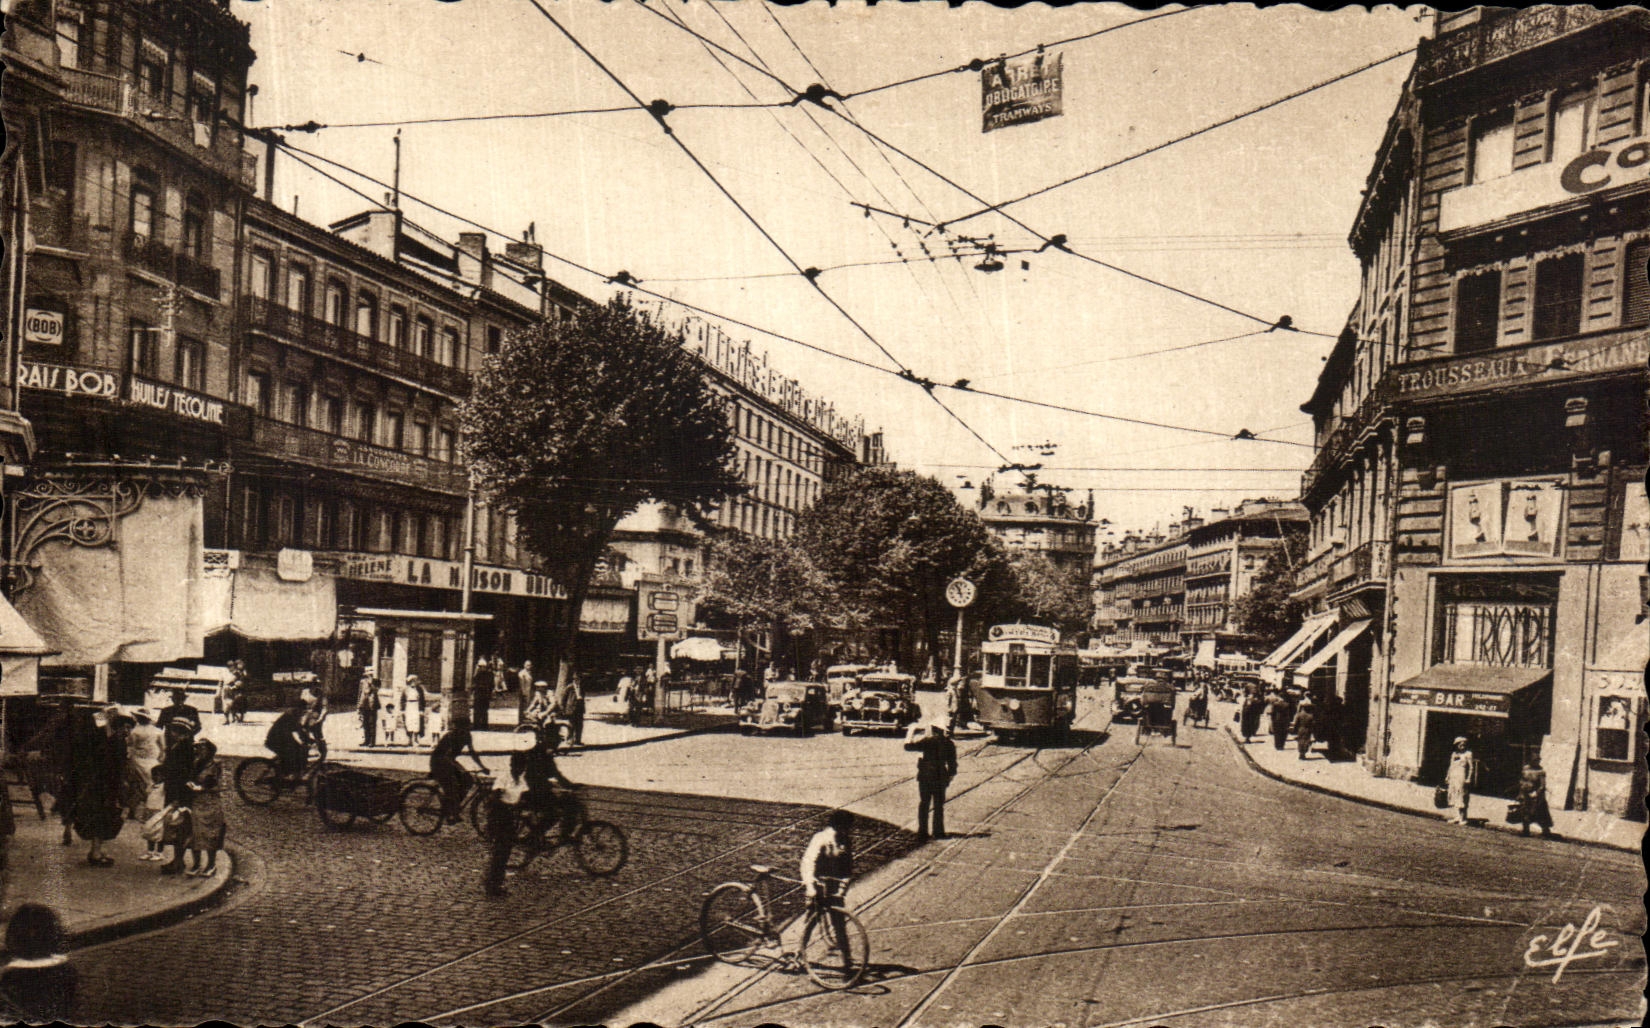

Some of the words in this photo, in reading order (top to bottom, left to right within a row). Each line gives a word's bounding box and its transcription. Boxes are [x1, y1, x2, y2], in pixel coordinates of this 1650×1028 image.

[985, 78, 1060, 106] OBLIGATOIRE
[993, 102, 1052, 123] TRAMWAYS
[32, 318, 57, 335] BOB
[66, 369, 116, 395] BOB
[1398, 355, 1528, 393] TROUSSEAUX
[131, 375, 170, 409] HUILES
[407, 560, 431, 584] LA
[449, 566, 512, 592] MISON
[1434, 692, 1465, 706] BAR
